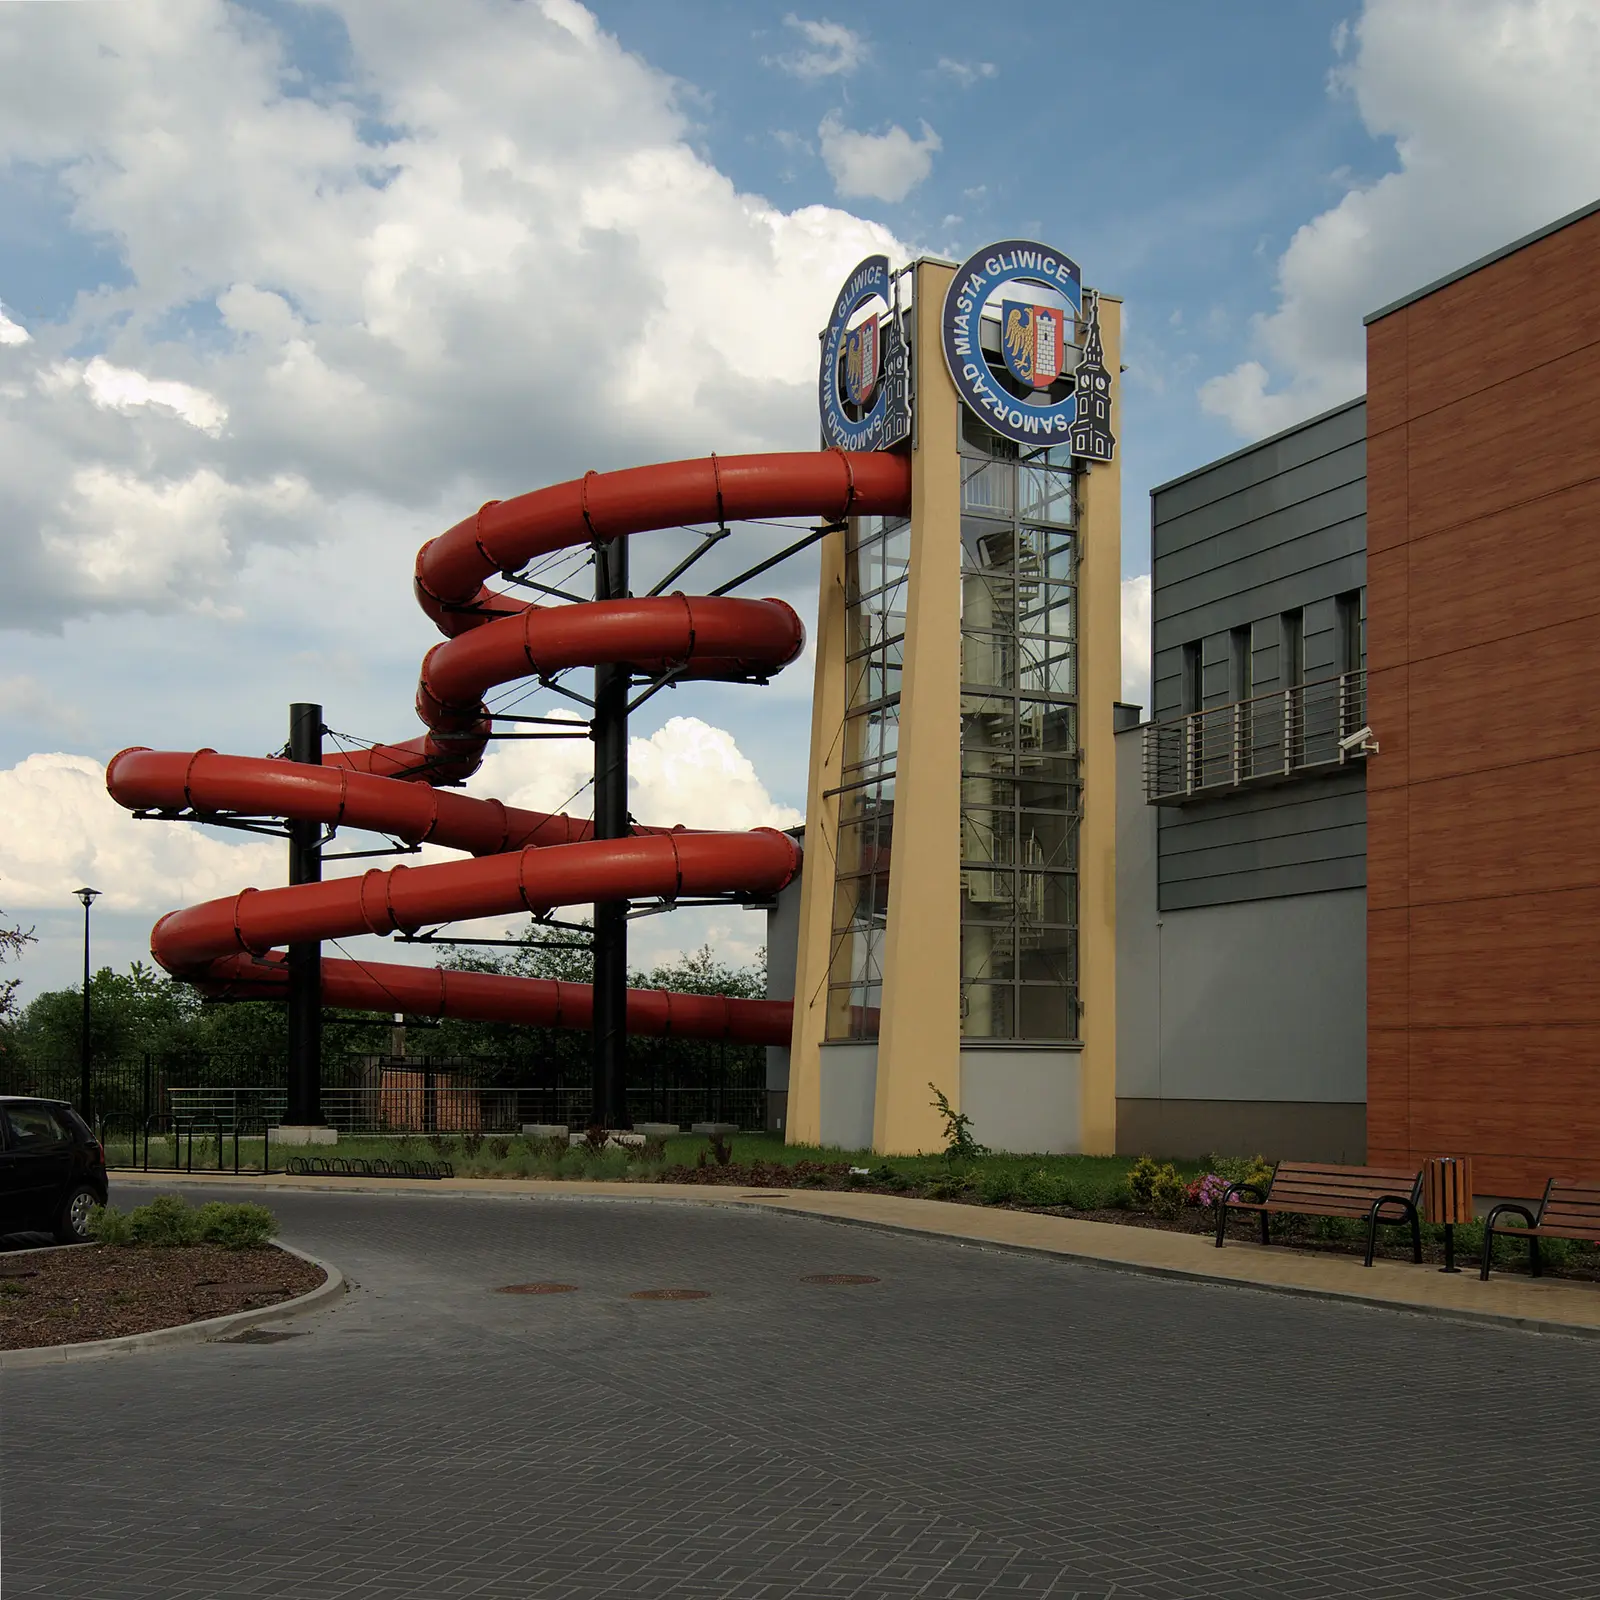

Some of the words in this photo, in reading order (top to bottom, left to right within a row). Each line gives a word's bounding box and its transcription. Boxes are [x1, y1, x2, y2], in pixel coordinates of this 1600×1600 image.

[838, 265, 883, 319] GLIWICE
[985, 250, 1071, 284] GLIWICE
[954, 273, 987, 355] MIASTA
[823, 325, 840, 411] MIASTA
[962, 363, 1068, 434] SAMORZĄD
[827, 411, 882, 451] SAMORZĄD
